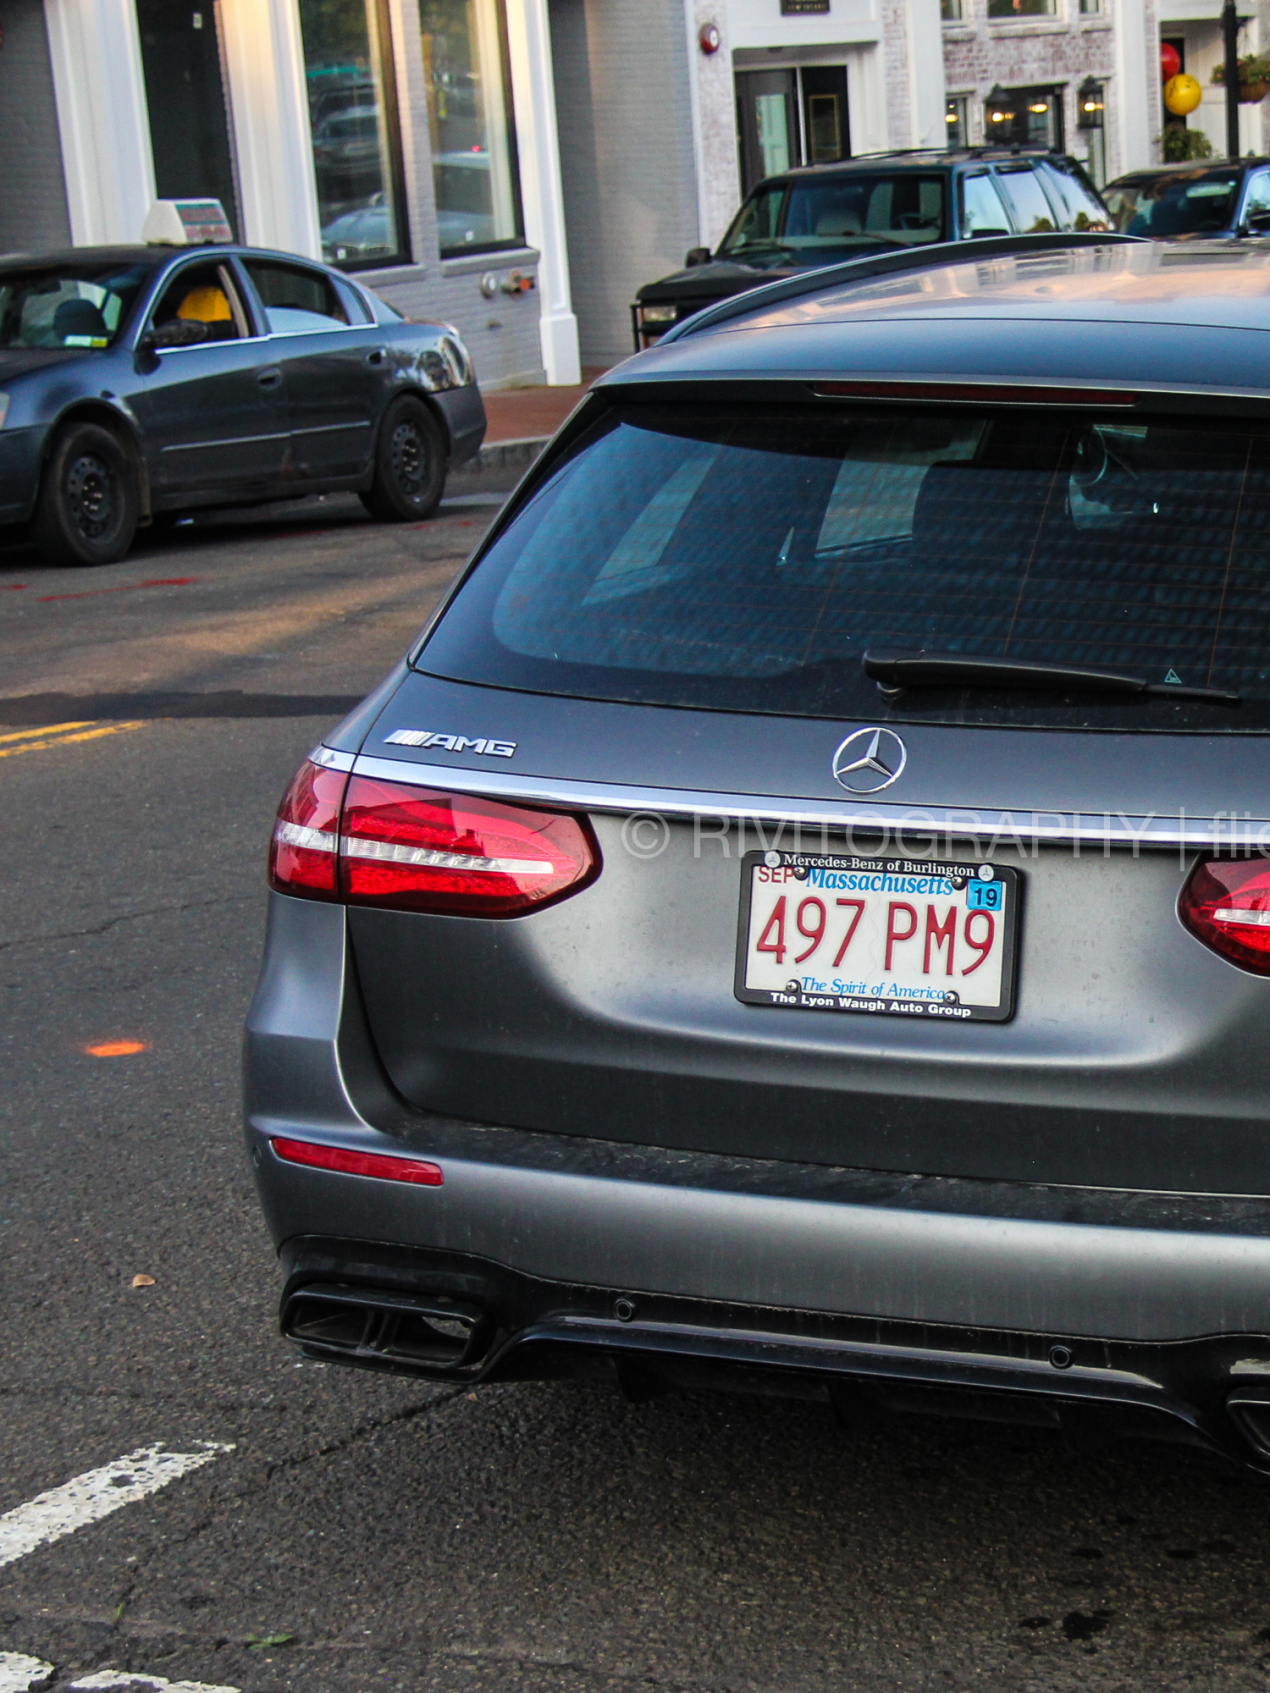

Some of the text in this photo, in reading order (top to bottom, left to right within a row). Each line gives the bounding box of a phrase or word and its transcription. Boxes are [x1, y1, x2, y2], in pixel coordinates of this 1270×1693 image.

[758, 867, 795, 883] SEP
[783, 853, 975, 878] Mercedes-Benz of Burlington
[806, 868, 954, 896] Massachusetts
[974, 887, 998, 907] 19
[756, 895, 995, 976] 497 PM9
[801, 976, 946, 1000] The Spirit of America
[770, 992, 972, 1018] The Lyon Waugh Auto Group
